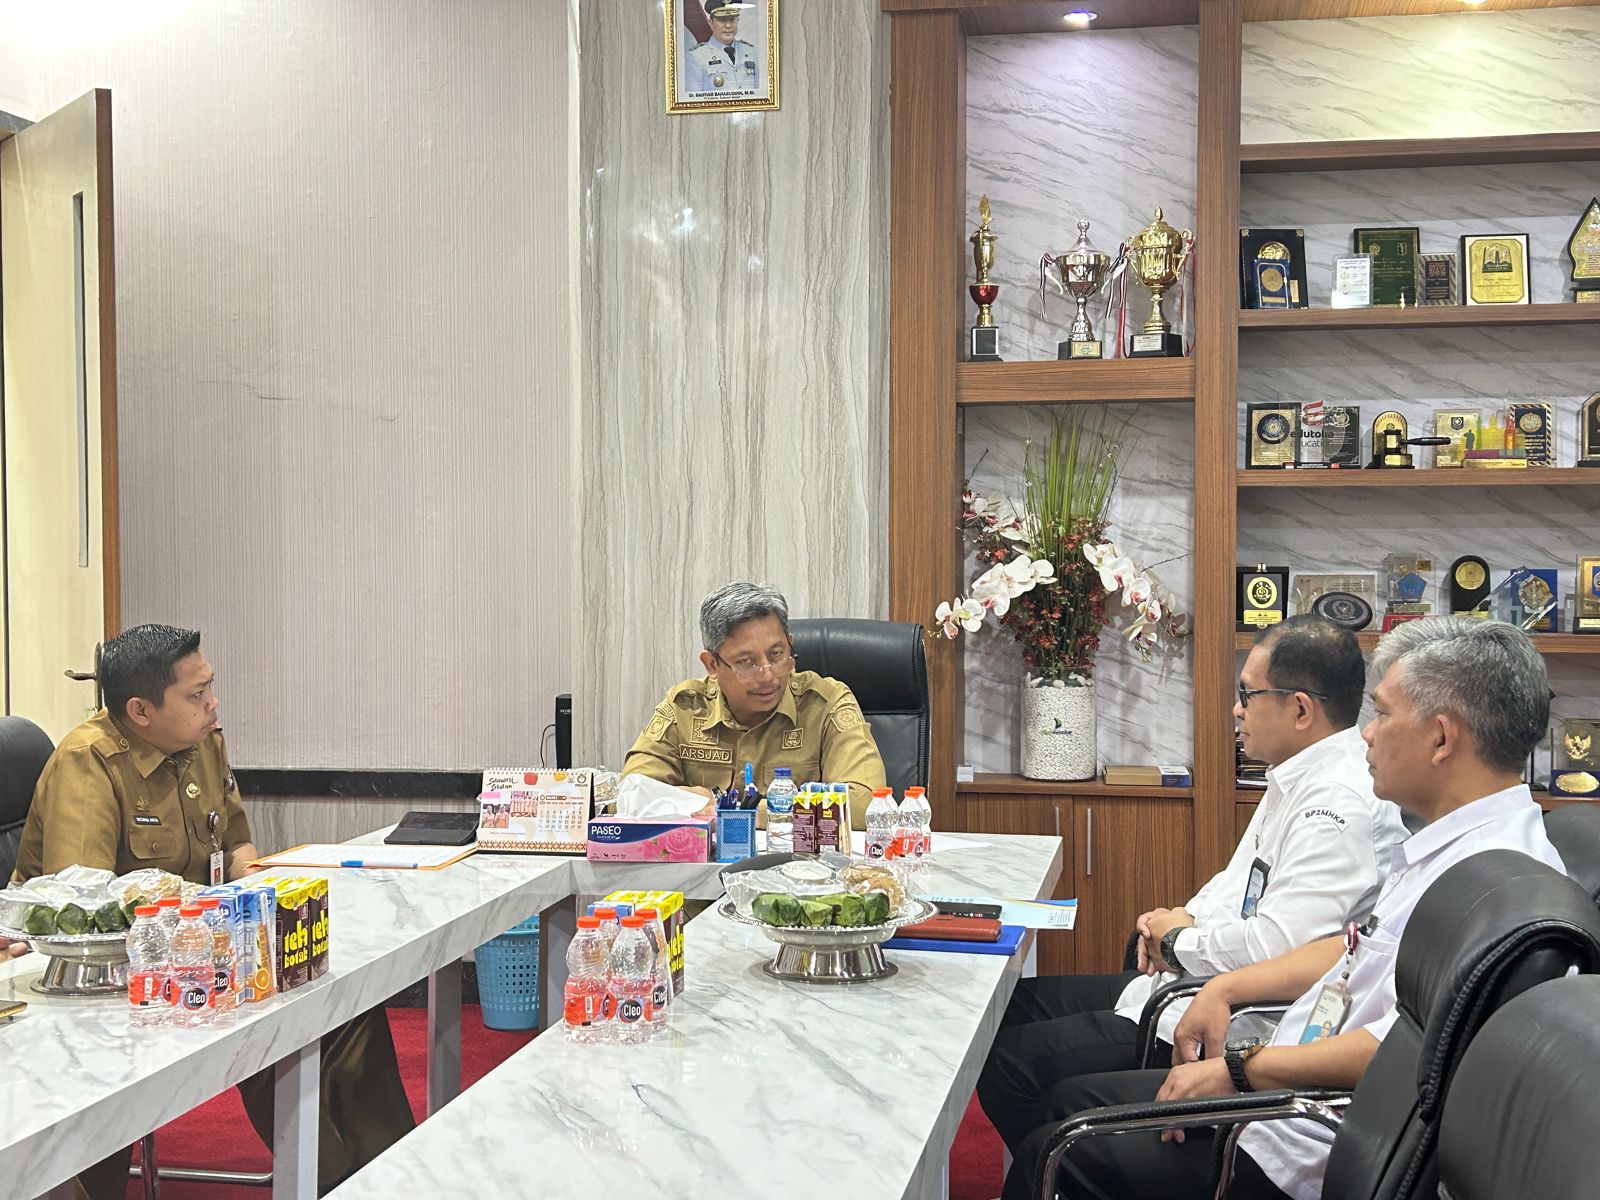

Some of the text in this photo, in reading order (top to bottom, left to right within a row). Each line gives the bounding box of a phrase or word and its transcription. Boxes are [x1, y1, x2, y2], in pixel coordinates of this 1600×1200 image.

[681, 747, 730, 760] ARSJAD
[591, 825, 621, 835] PASEO
[284, 920, 308, 953] teh
[284, 947, 308, 969] kotak
[188, 992, 206, 1004] Cleo
[623, 1004, 641, 1016] Cleo
